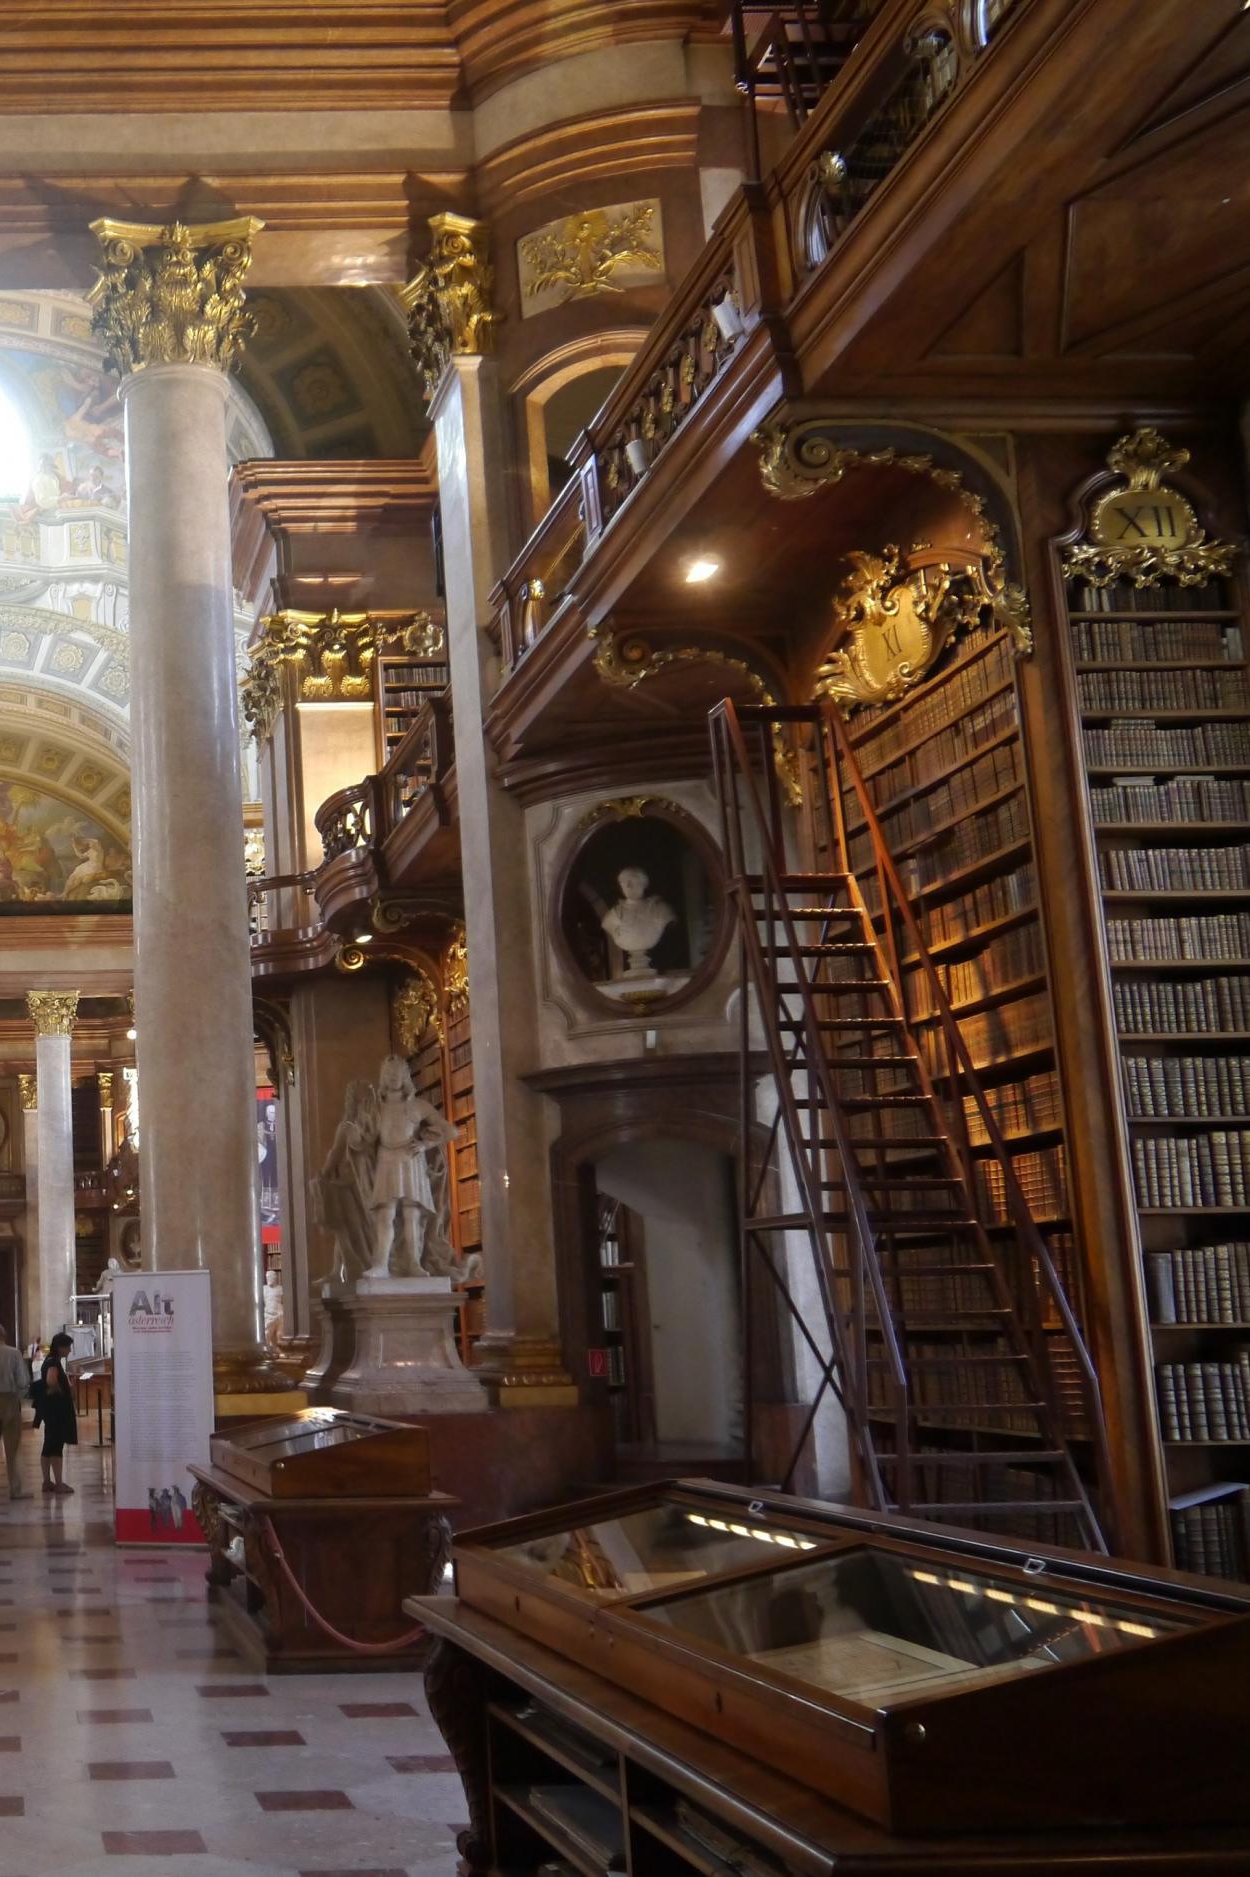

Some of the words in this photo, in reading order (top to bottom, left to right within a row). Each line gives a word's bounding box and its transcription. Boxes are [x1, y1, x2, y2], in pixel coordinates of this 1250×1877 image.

[1112, 505, 1176, 540] XII
[881, 624, 903, 662] XI
[129, 1289, 175, 1315] Alt
